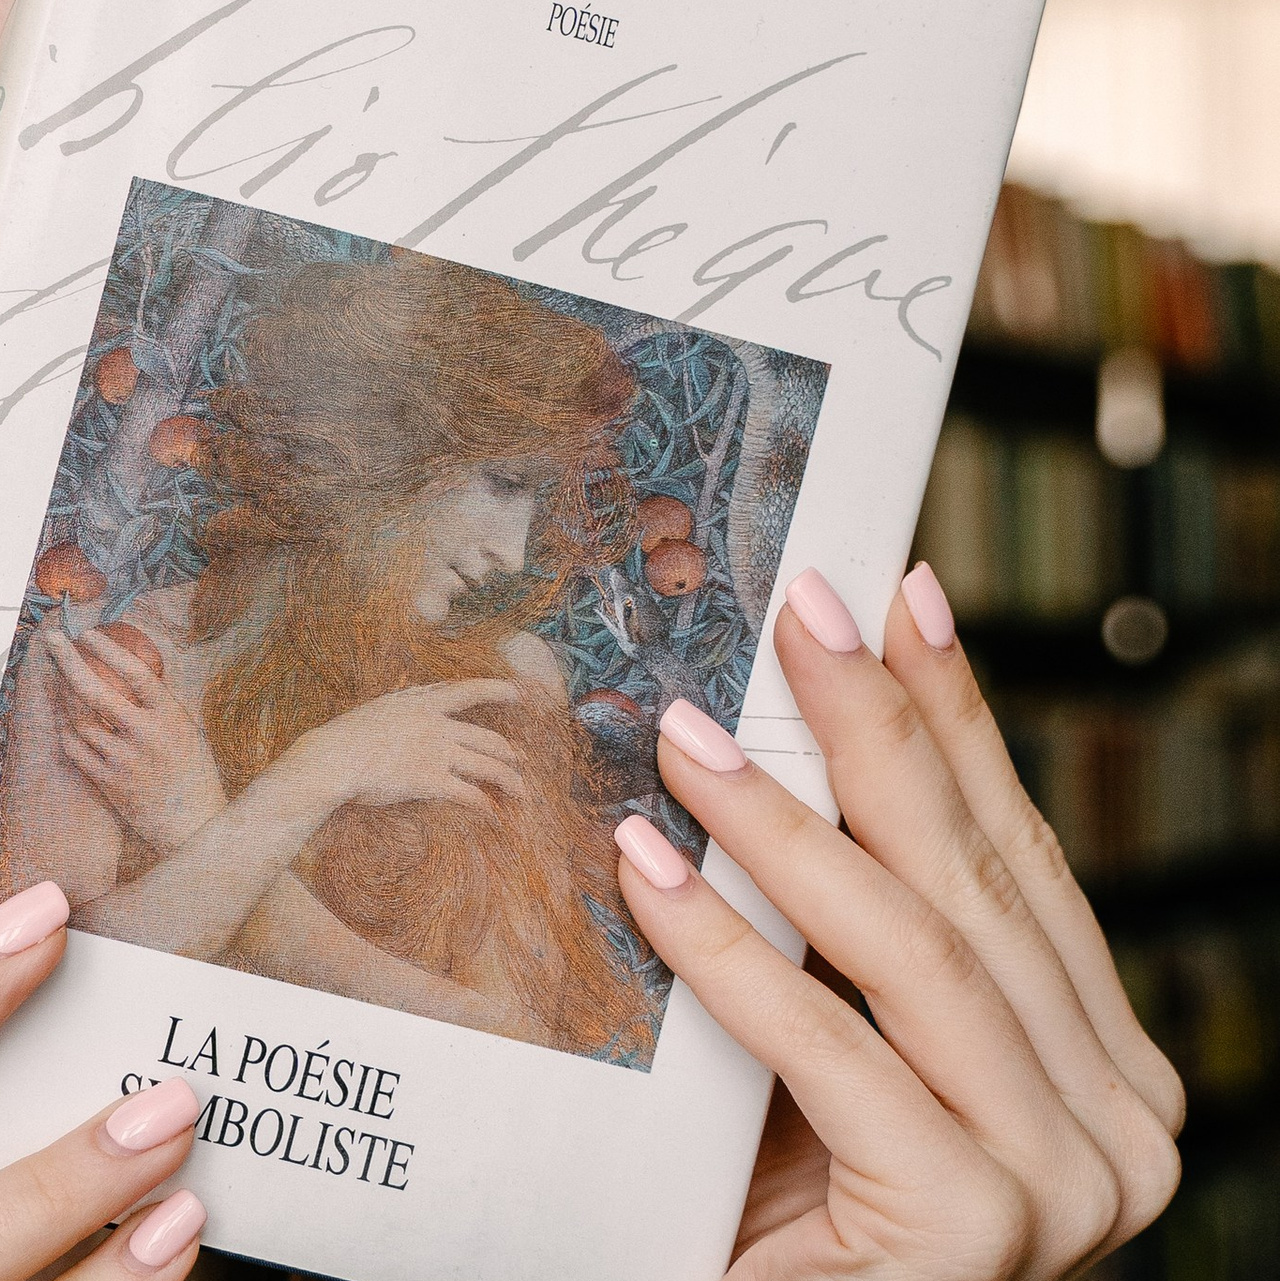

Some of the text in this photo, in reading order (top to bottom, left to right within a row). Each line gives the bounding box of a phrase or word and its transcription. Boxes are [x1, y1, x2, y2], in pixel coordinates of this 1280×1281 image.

[545, 2, 620, 49] POÉSIE
[157, 1015, 402, 1120] LA POÉSIE
